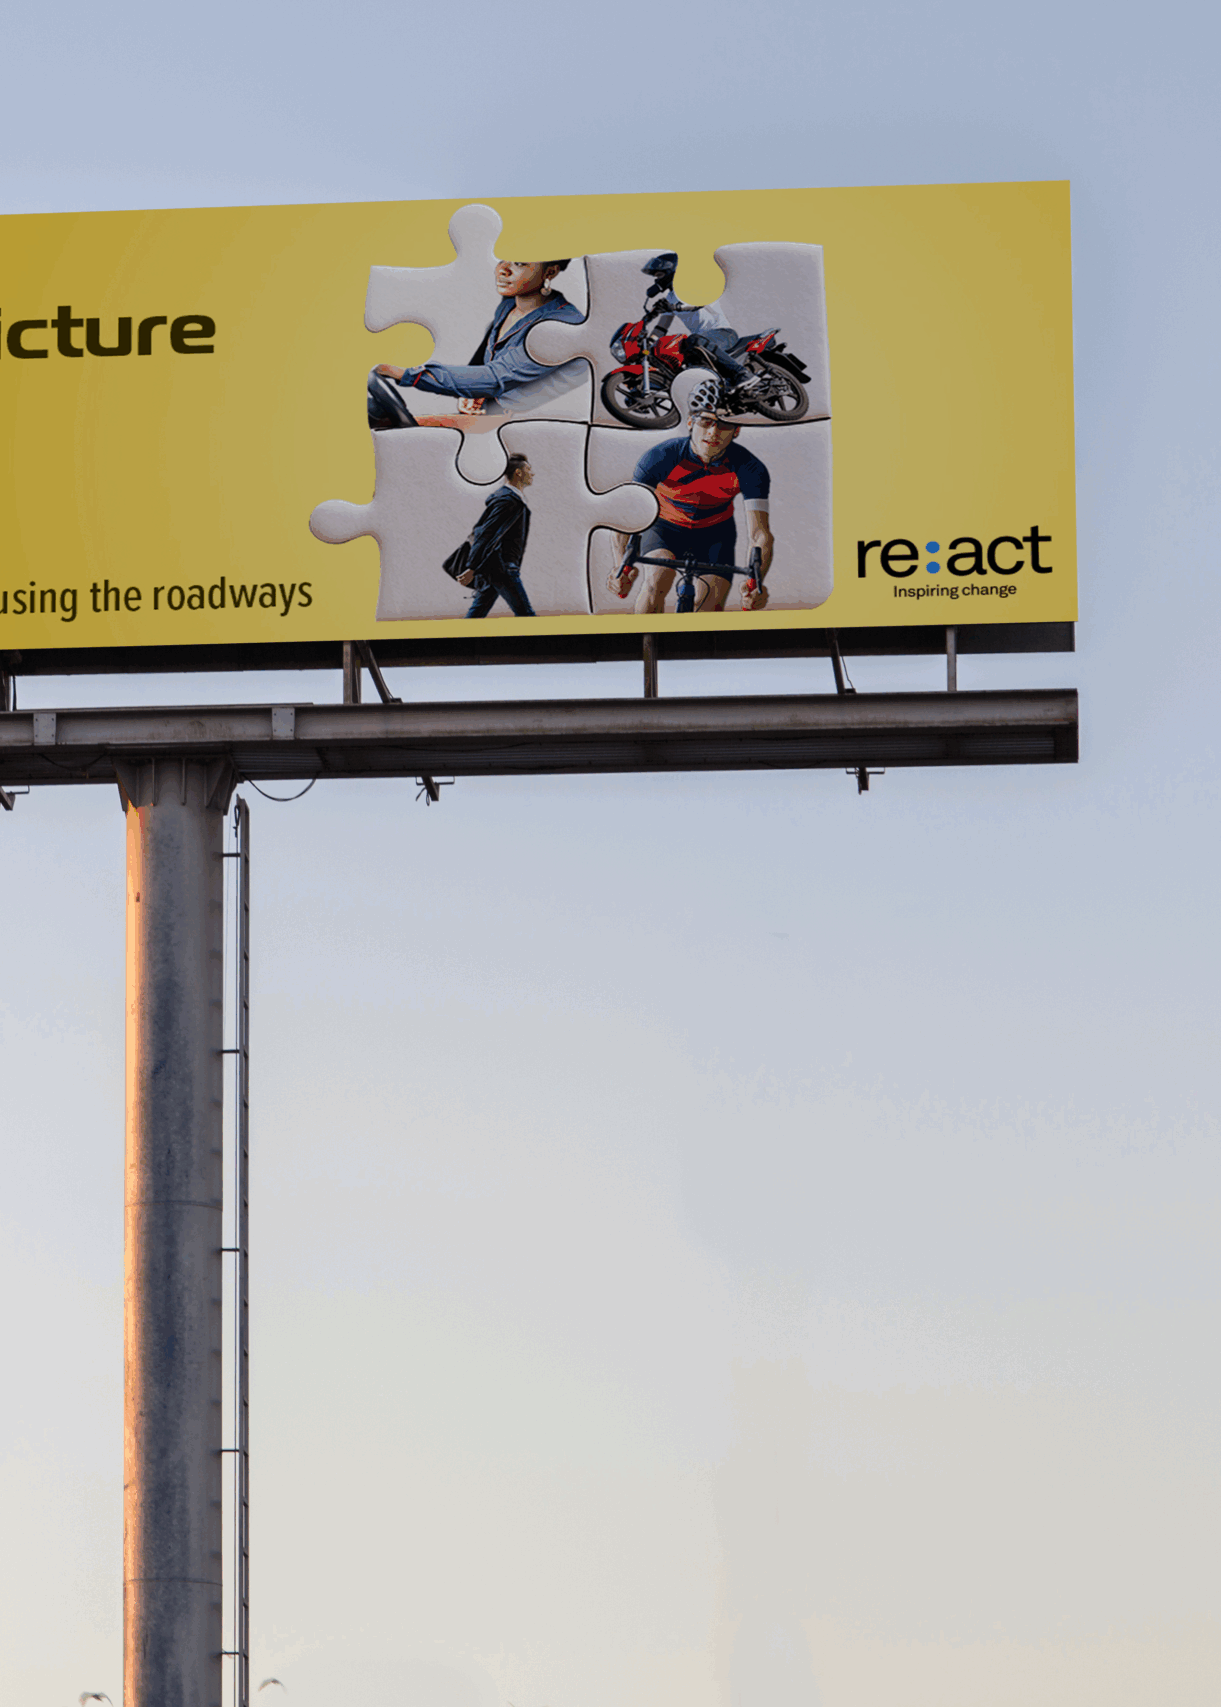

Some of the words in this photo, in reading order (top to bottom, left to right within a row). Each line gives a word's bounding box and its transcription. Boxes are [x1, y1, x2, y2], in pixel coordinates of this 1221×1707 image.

[858, 525, 1052, 578] re:act
[90, 580, 141, 612] the
[154, 576, 312, 616] roadways
[894, 585, 959, 600] Inspiring
[962, 584, 1017, 598] change
